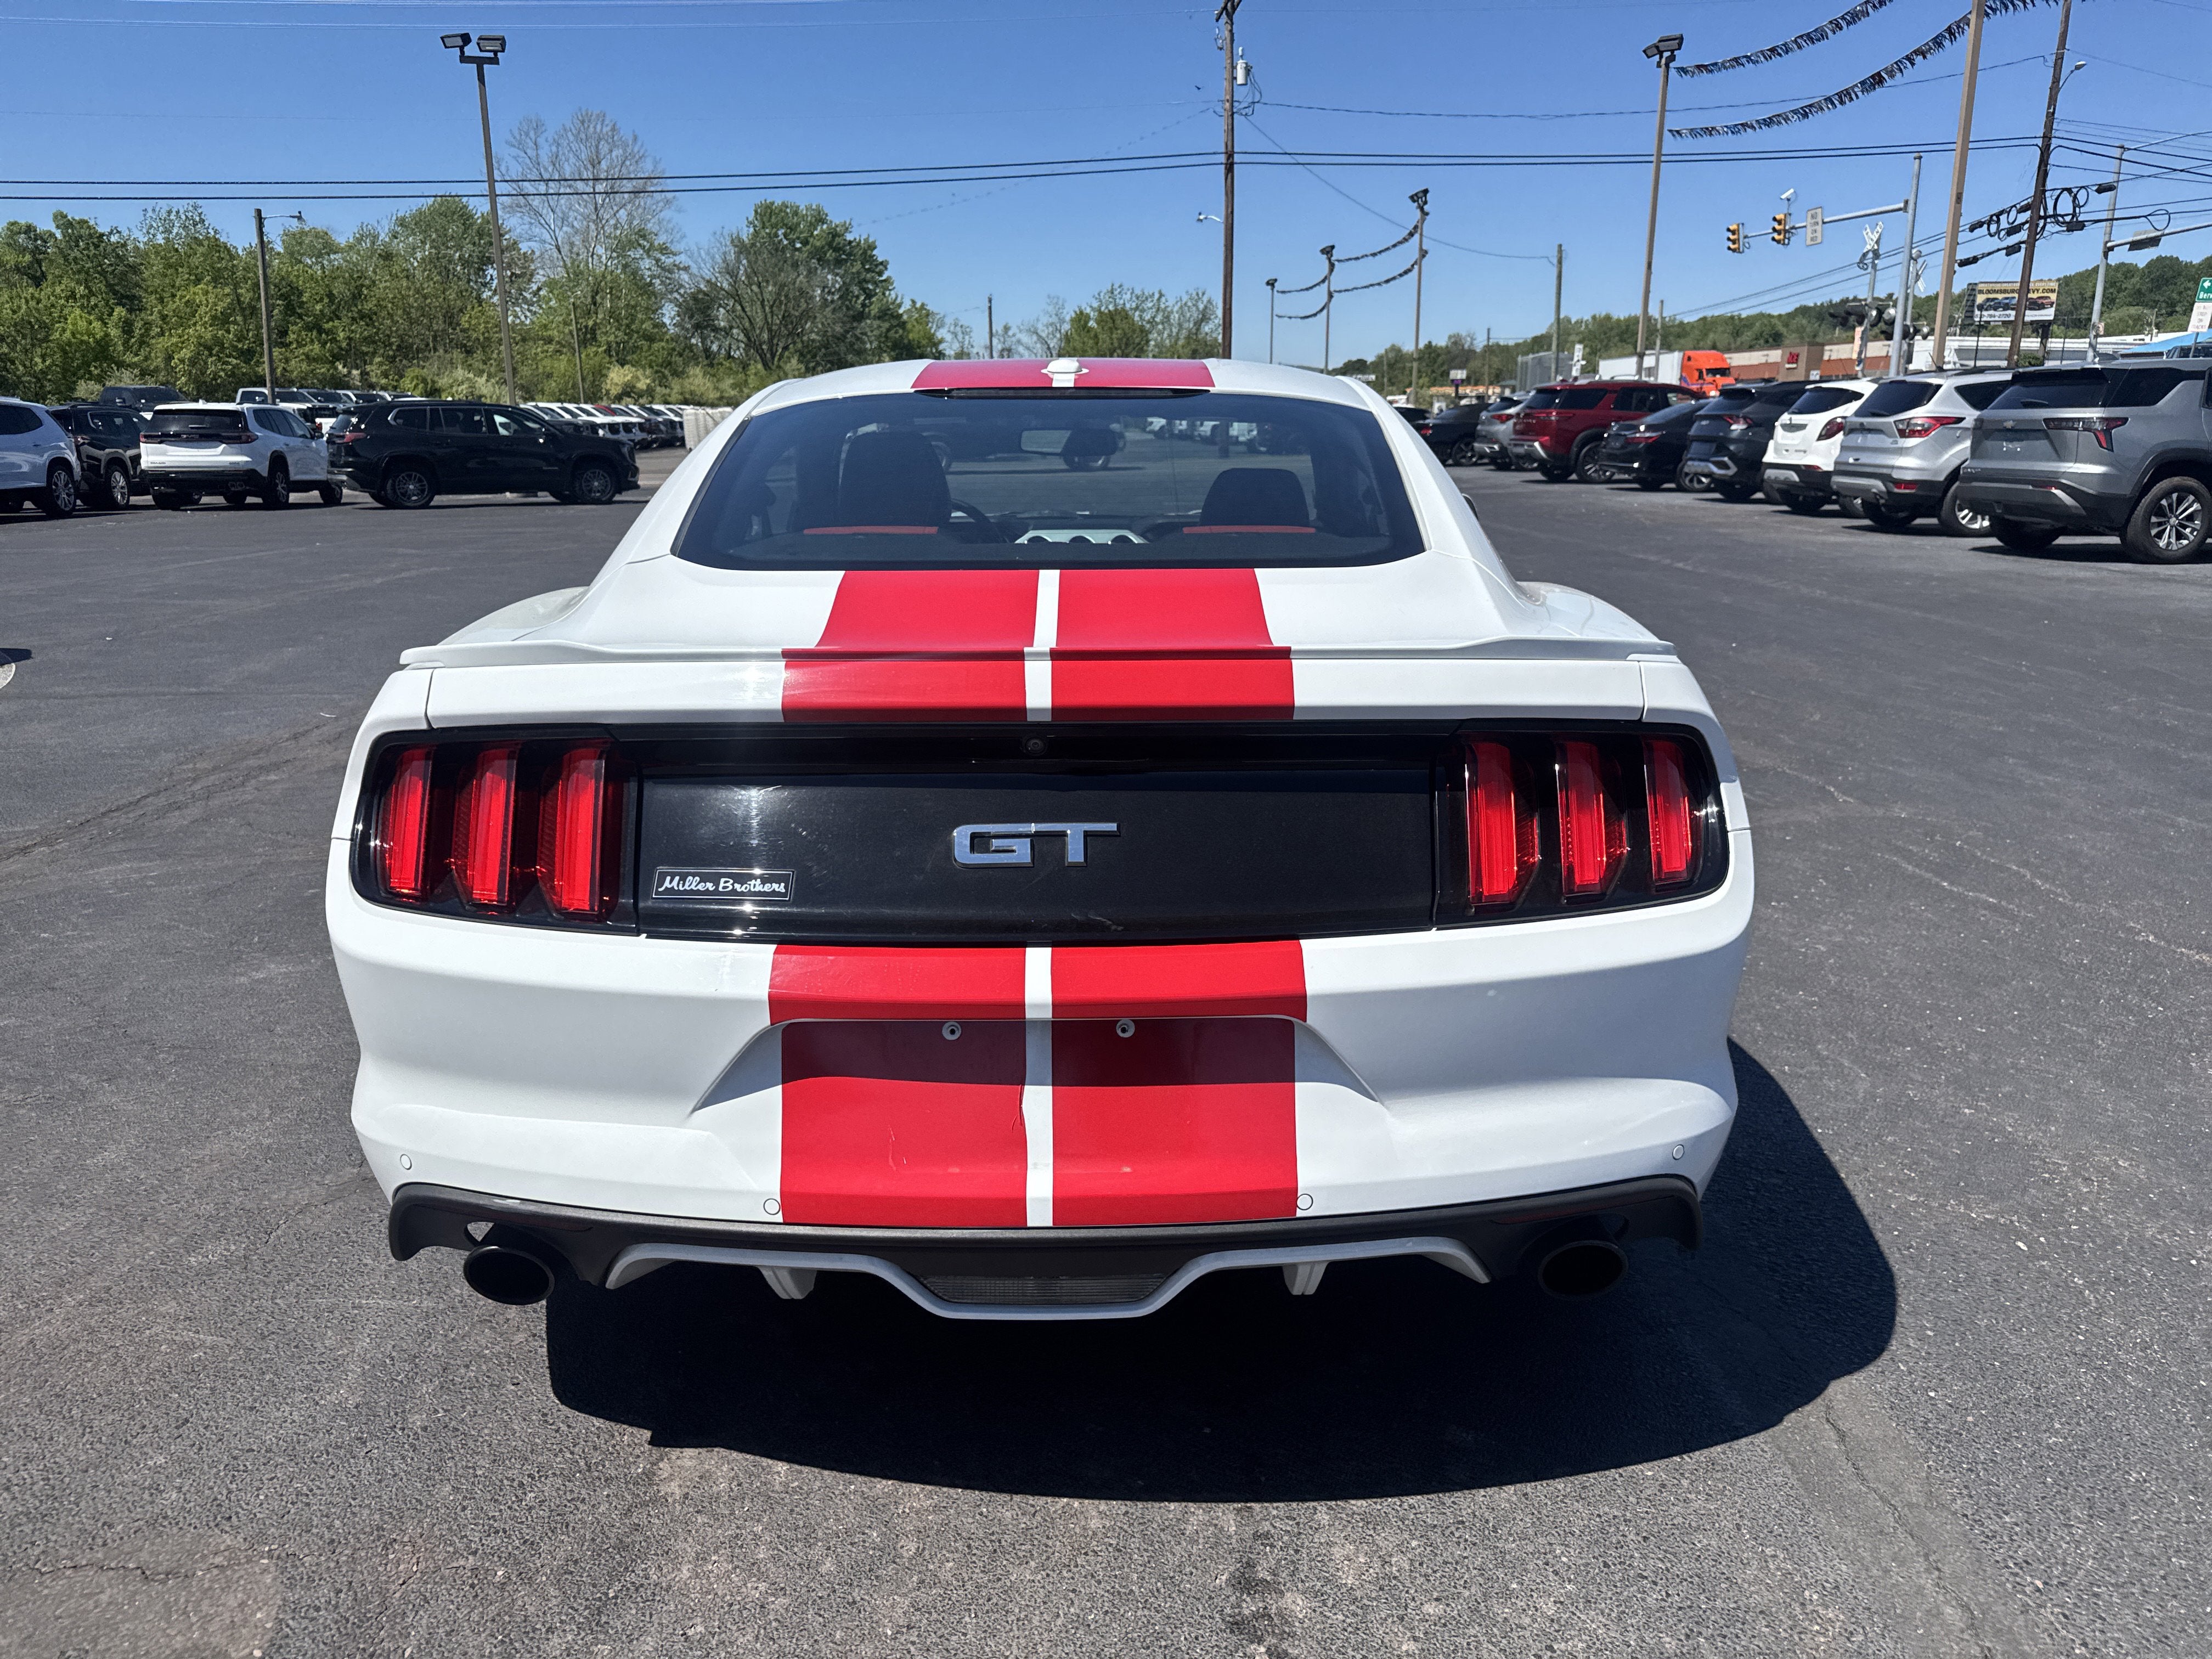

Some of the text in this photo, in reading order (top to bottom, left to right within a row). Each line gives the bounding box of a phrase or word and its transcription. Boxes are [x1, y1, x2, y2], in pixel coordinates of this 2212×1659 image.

[952, 822, 1121, 868] GT
[658, 876, 786, 893] Miller Brothers
